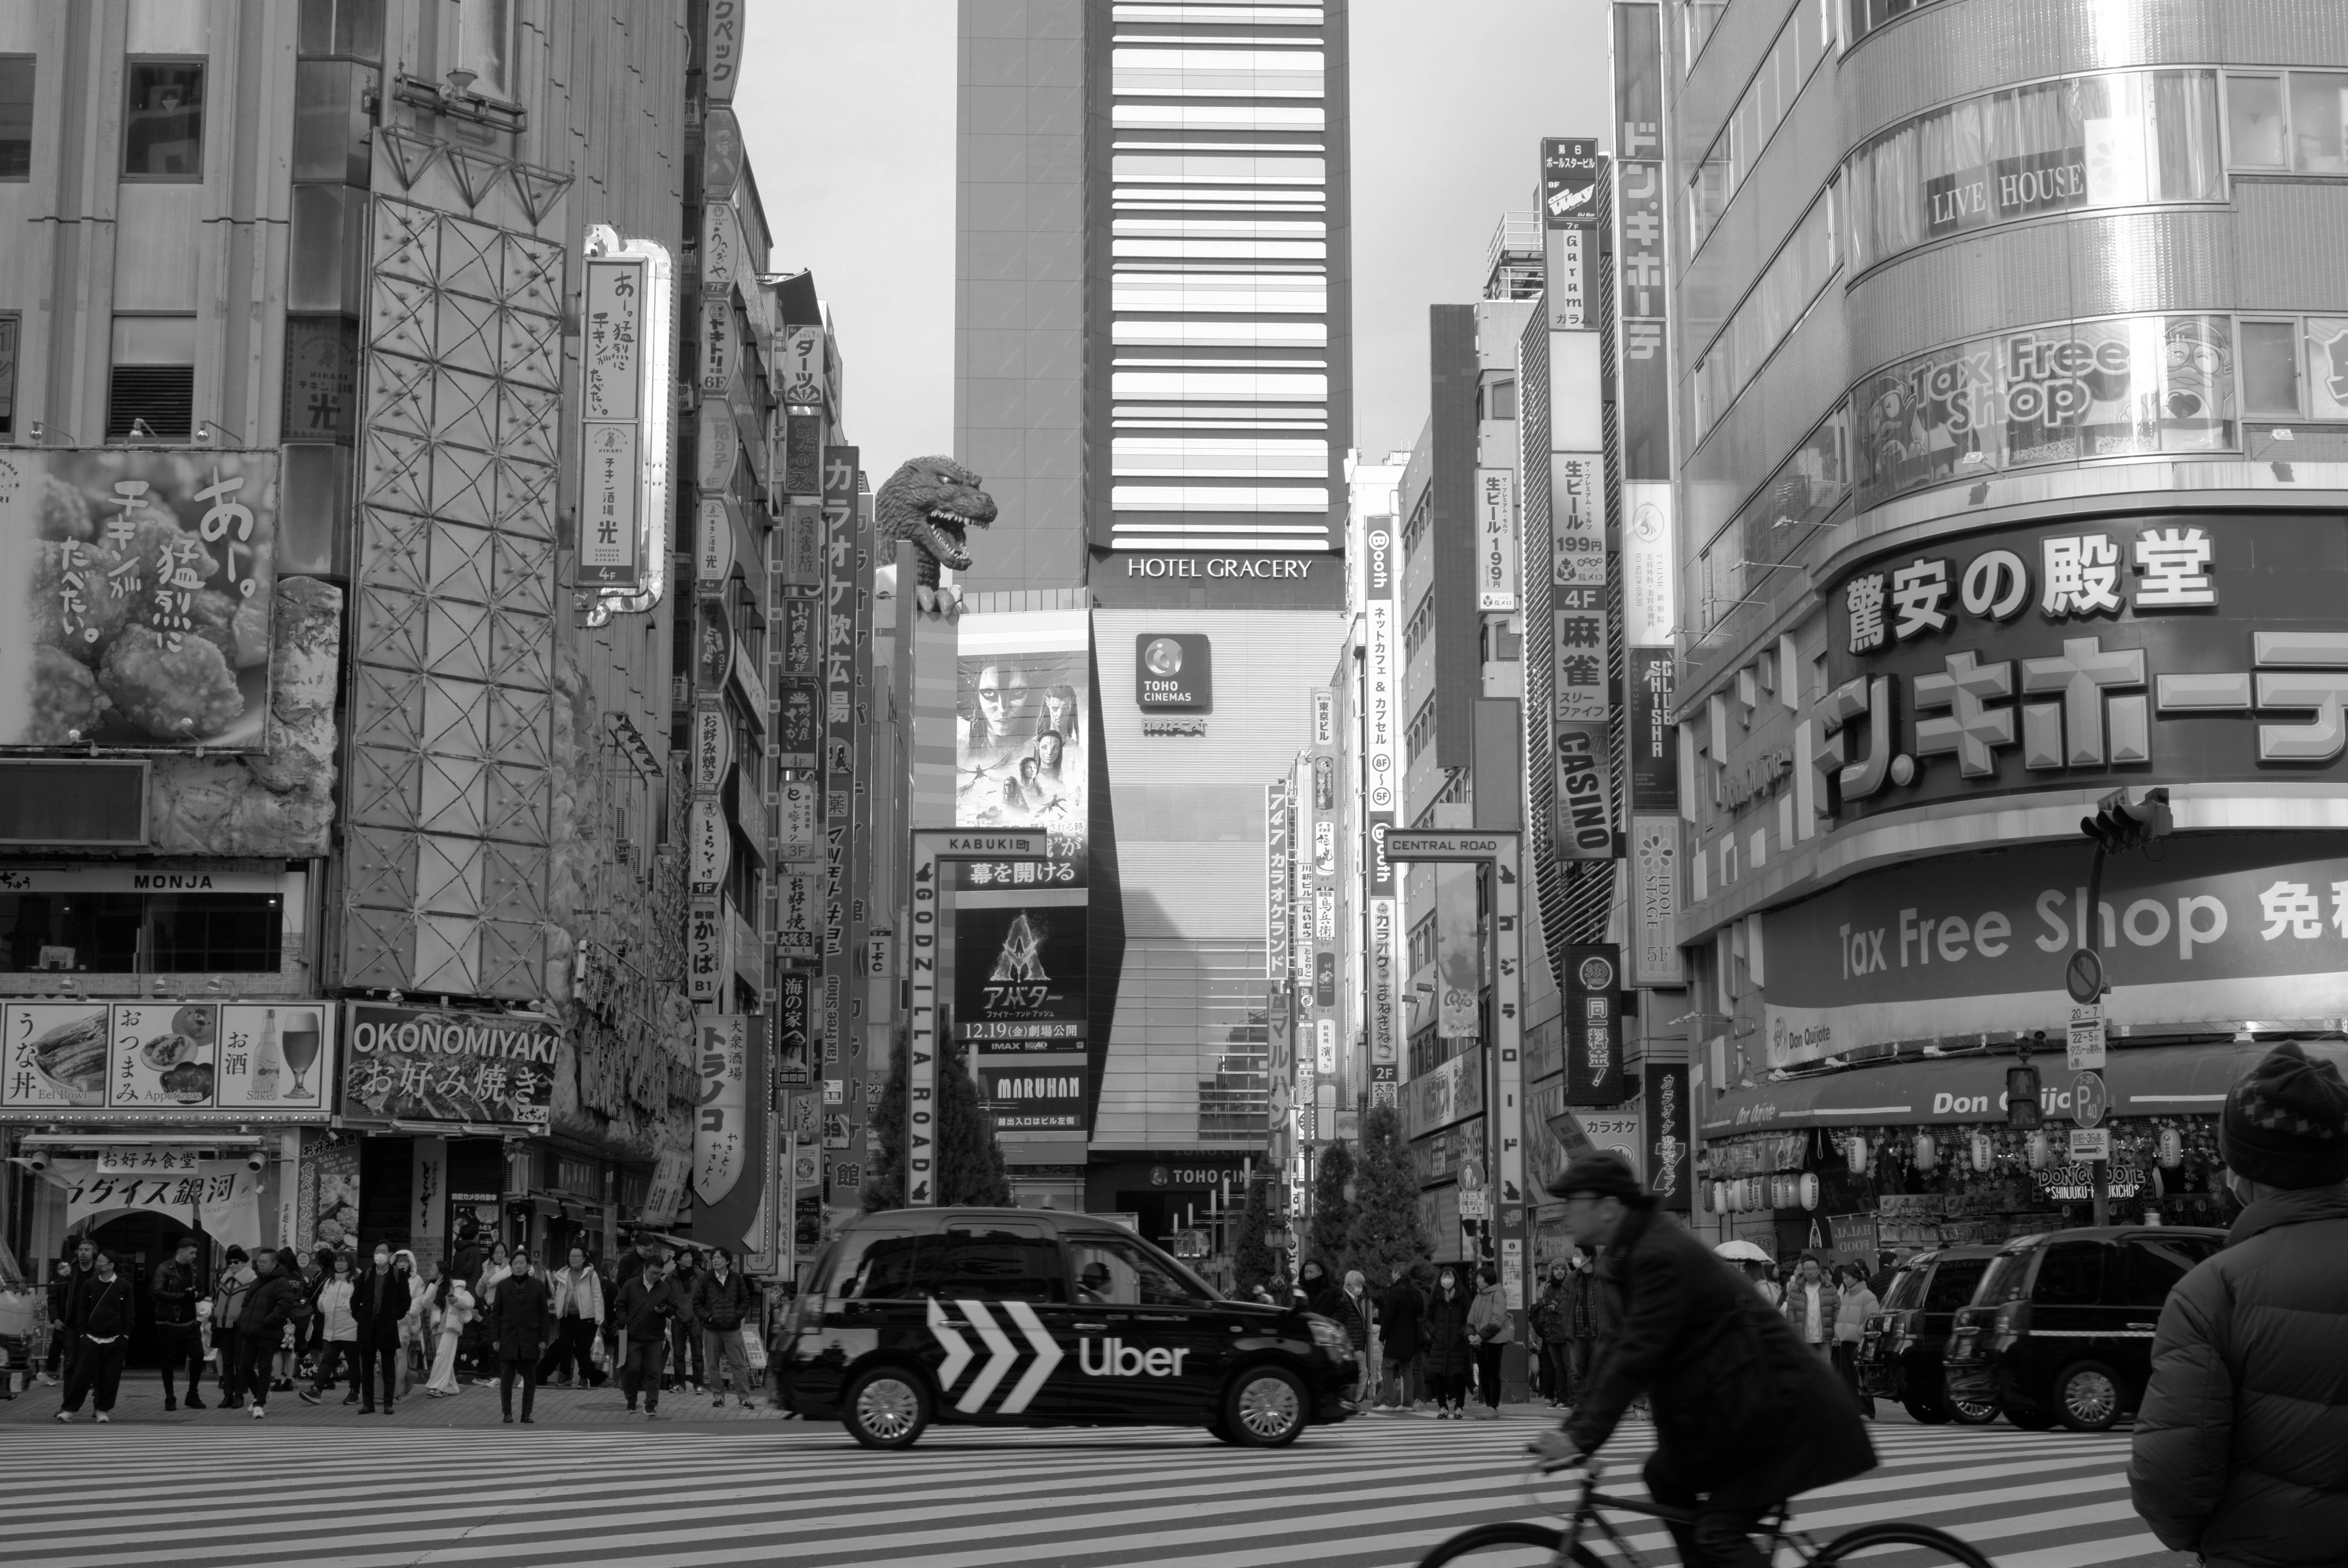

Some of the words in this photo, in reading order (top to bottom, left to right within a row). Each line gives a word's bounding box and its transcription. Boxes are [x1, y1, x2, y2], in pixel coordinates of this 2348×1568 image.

[1558, 143, 1566, 155] 第
[1574, 145, 1582, 155] 6
[1933, 181, 1987, 225] LIVE
[1999, 163, 2084, 208] HOUSE
[710, 283, 723, 291] 7F
[1565, 234, 1583, 308] Garam
[614, 271, 635, 318] あー。
[591, 311, 611, 366] チキンが
[1555, 313, 1593, 326] ガラム
[612, 321, 635, 371] 猛烈に
[709, 318, 725, 368] ヤキトリ
[796, 338, 816, 389] ダーツ
[590, 368, 609, 416] たべたい。
[704, 376, 727, 389] 6F
[1908, 352, 1995, 408] Tax
[2007, 333, 2133, 382] Free
[1947, 376, 2092, 434] Shop
[788, 428, 819, 489] 海の家
[603, 457, 615, 517] チキン酒場
[1485, 476, 1502, 534] 生ビール
[1564, 460, 1584, 530] 生ビール
[1584, 460, 1593, 530] ザ・プレミアム・モルツ
[108, 480, 150, 599] チキンが
[194, 466, 256, 598] あー。
[598, 520, 619, 544] 光
[1556, 537, 1603, 552] 199円
[599, 566, 616, 580] 4F
[706, 555, 717, 568] 光
[1128, 558, 1202, 578] HOTEL
[1207, 559, 1312, 579] GRACERY
[1368, 529, 1390, 589] Booth
[1490, 537, 1503, 589] 199円
[1578, 573, 1603, 581] 鳥メロ
[59, 536, 99, 643] たべたい。
[153, 539, 205, 652] 猛烈に
[1564, 590, 1597, 608] 4F
[1647, 554, 1655, 628] 美容外科・美容皮膚科
[1846, 526, 2216, 653] 驚安の殿堂
[788, 601, 810, 663] 山内農場
[1374, 607, 1387, 675] ネットカフェ
[1561, 615, 1602, 688] 麻雀
[794, 663, 805, 672] 5F
[1144, 681, 1178, 691] TOHO
[1376, 681, 1386, 692] &
[1144, 693, 1192, 702] CINEMAS
[1558, 692, 1595, 704] スリー
[1558, 705, 1605, 718] ファイブ
[1650, 661, 1662, 757] SHISHA
[798, 704, 811, 741] 焼肉屋
[1319, 702, 1330, 741] 東京ビル
[1375, 698, 1387, 745] カプセル
[702, 714, 717, 782] お好み焼き
[790, 755, 806, 767] 4F
[1557, 731, 1610, 850] CASINO
[701, 819, 716, 880] とらそば
[789, 845, 806, 857] 3F
[1392, 840, 1457, 852] CENTRAL
[1459, 840, 1497, 852] ROAD
[134, 875, 213, 889] MONJA
[697, 883, 712, 894] 1F
[970, 862, 1075, 884] 幕を開ける
[1301, 864, 1312, 898] 川新ビル
[694, 910, 715, 920] 新宿
[786, 877, 806, 931] お好み焼
[1645, 875, 1659, 929] STAGE
[1659, 876, 1671, 919] IDOL
[693, 920, 715, 975] かっぱ
[779, 933, 811, 946] 大阪家
[1376, 914, 1392, 970] カラオケ
[1647, 946, 1671, 962] 5F
[1840, 923, 1888, 980] Tax
[1899, 907, 2012, 968] Free
[2035, 886, 2229, 960] Shop
[695, 980, 712, 992] B1
[825, 975, 841, 1009] Shop
[914, 888, 934, 1066] GODZILLA
[1584, 963, 1608, 978] 365
[785, 978, 803, 1028] 海の家
[982, 986, 1064, 1010] アバター
[825, 1010, 838, 1039] Free
[1374, 982, 1394, 1061] まねきねこ
[1499, 915, 1517, 1152] ゴジラロード
[1789, 1027, 1803, 1050] Don
[1804, 1023, 1831, 1049] Quijote
[9, 1013, 37, 1100] うな丼
[116, 1009, 141, 1102] おつまみ
[224, 1031, 249, 1075] お酒
[353, 1022, 560, 1065] OKONOMIYAKI
[729, 1019, 744, 1082] 大衆酒場
[825, 1041, 838, 1065] Tax
[361, 1059, 544, 1103] お好み焼き
[700, 1026, 727, 1133] トラノコ
[997, 1077, 1079, 1098] MARUHAN
[1270, 1015, 1289, 1128] マルハン
[1376, 1067, 1393, 1079] 2F
[2079, 1076, 2094, 1085] 7-20
[39, 1089, 58, 1100] Eel
[60, 1089, 87, 1100] Bowl
[144, 1089, 203, 1102] Appetizers
[246, 1090, 272, 1101] Sake
[1933, 1092, 1989, 1114] Don
[2077, 1085, 2091, 1120] P
[2086, 1103, 2098, 1120] 40
[912, 1086, 931, 1173] ROAD
[1587, 1120, 1638, 1134] カラオケ
[102, 1151, 197, 1169] お好み食堂
[702, 1141, 722, 1187] やきとん
[719, 1132, 738, 1178] やきとり
[1172, 1169, 1218, 1184] TOHO
[297, 1162, 315, 1253] 食べ飲み放題
[1079, 1336, 1191, 1378] Uber
